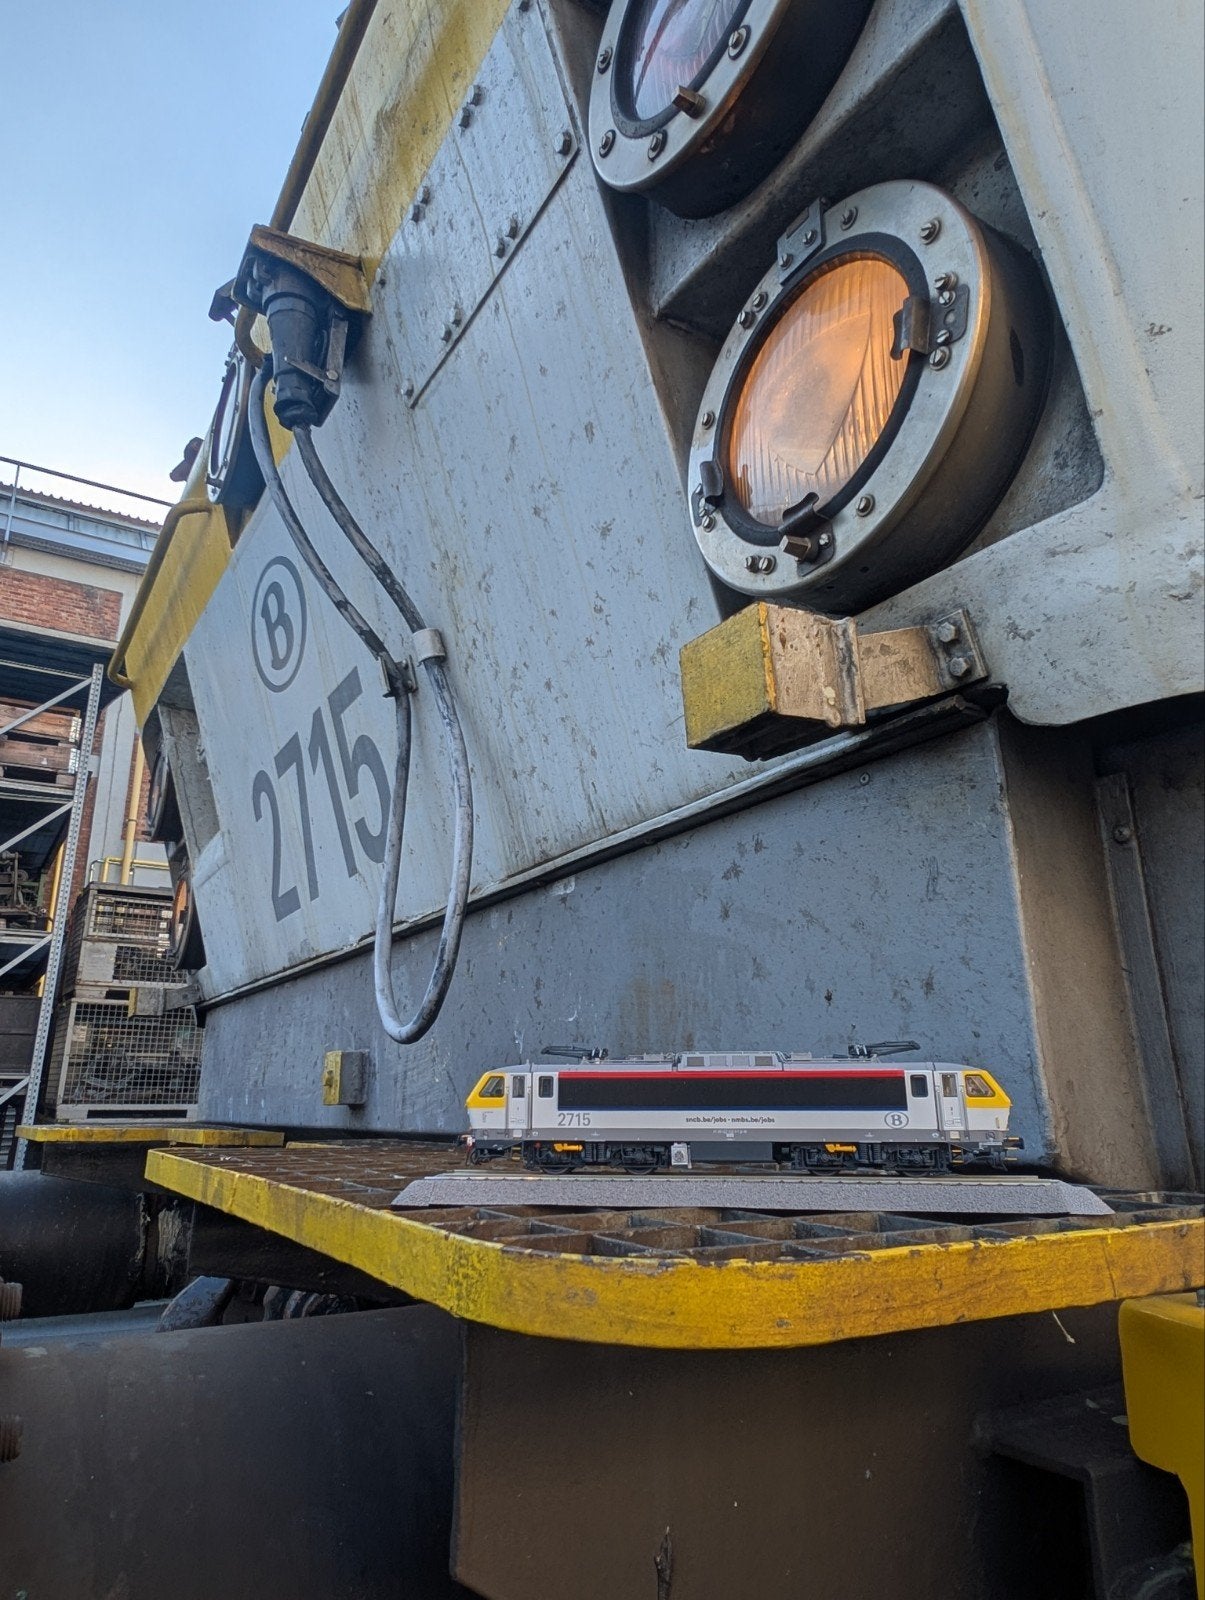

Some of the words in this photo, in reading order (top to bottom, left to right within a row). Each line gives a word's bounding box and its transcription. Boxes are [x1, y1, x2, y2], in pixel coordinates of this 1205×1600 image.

[252, 666, 392, 922] 2715
[557, 1113, 591, 1126] 2715
[685, 1116, 727, 1124] sncb.be/jobs
[731, 1116, 775, 1124] nmbs.be/jobs
